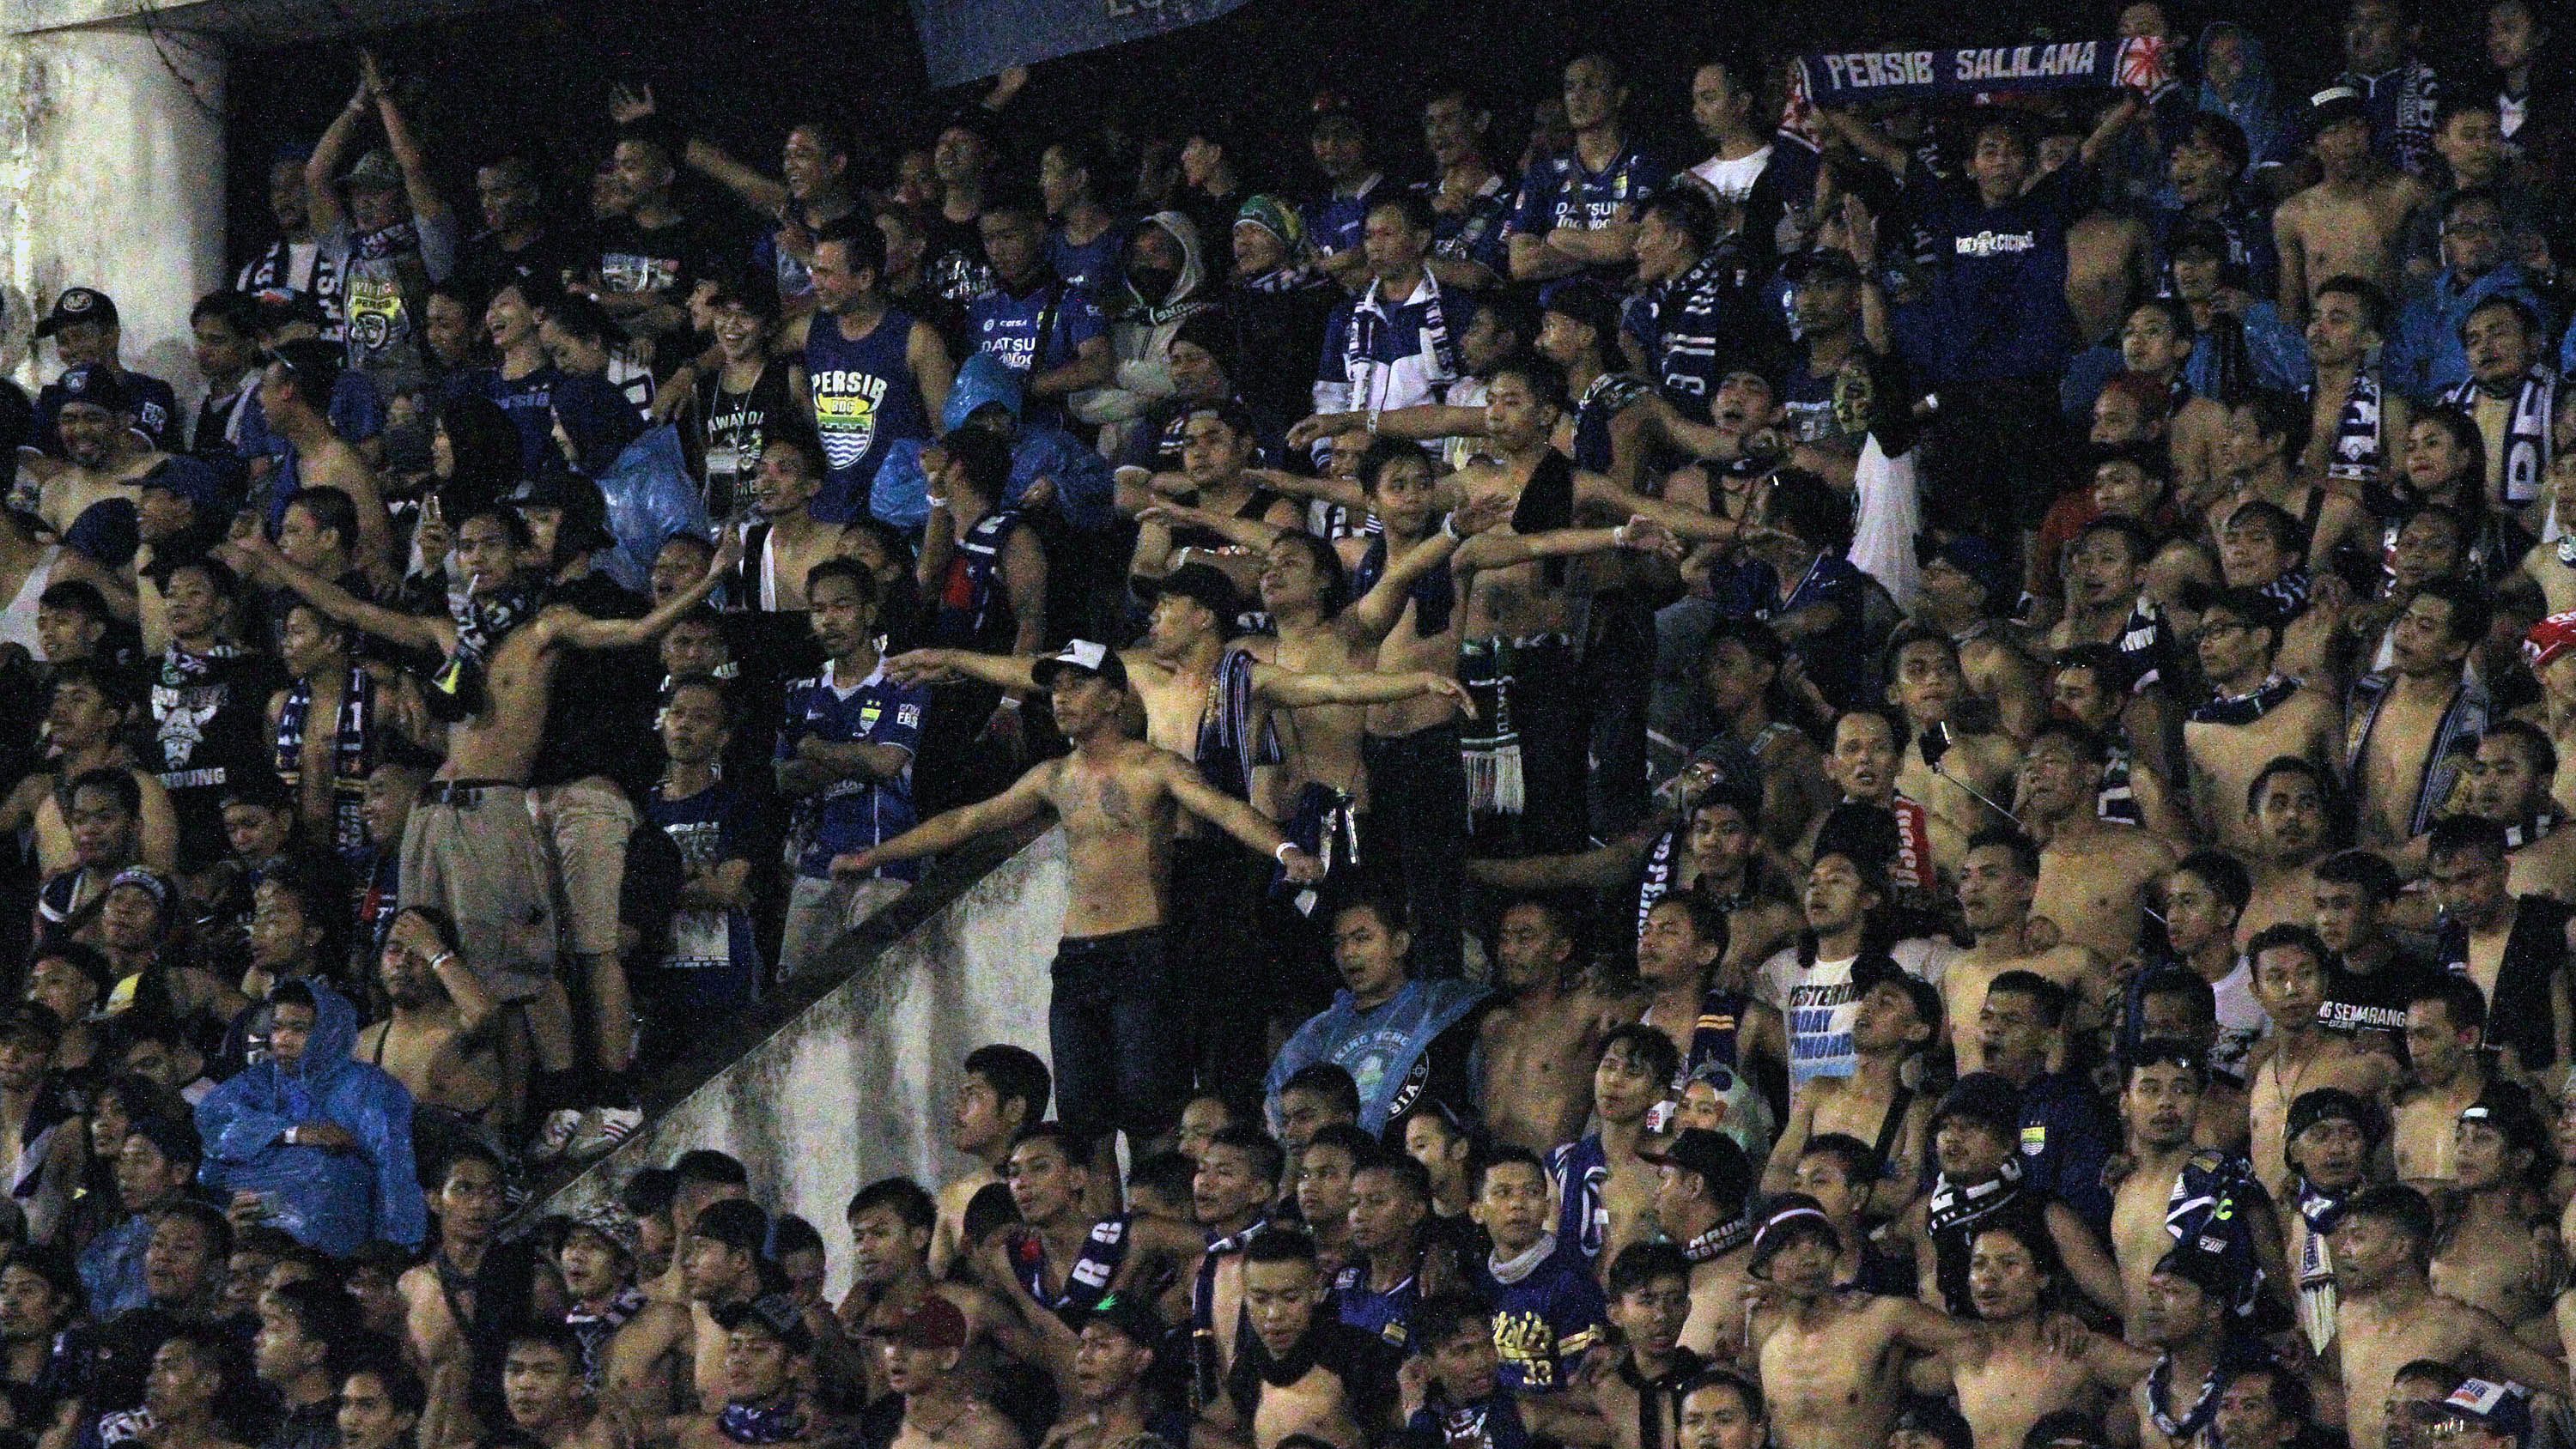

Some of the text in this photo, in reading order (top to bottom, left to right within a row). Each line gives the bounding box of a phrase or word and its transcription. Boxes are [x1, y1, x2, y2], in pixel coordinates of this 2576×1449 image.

[1824, 52, 1933, 89] PERSIB
[981, 337, 1036, 352] DATSU
[811, 370, 888, 403] PERSIB
[156, 767, 227, 789] NDUNG
[1789, 983, 1855, 1007] YESTERDA
[2334, 1003, 2405, 1028] SEMARANG
